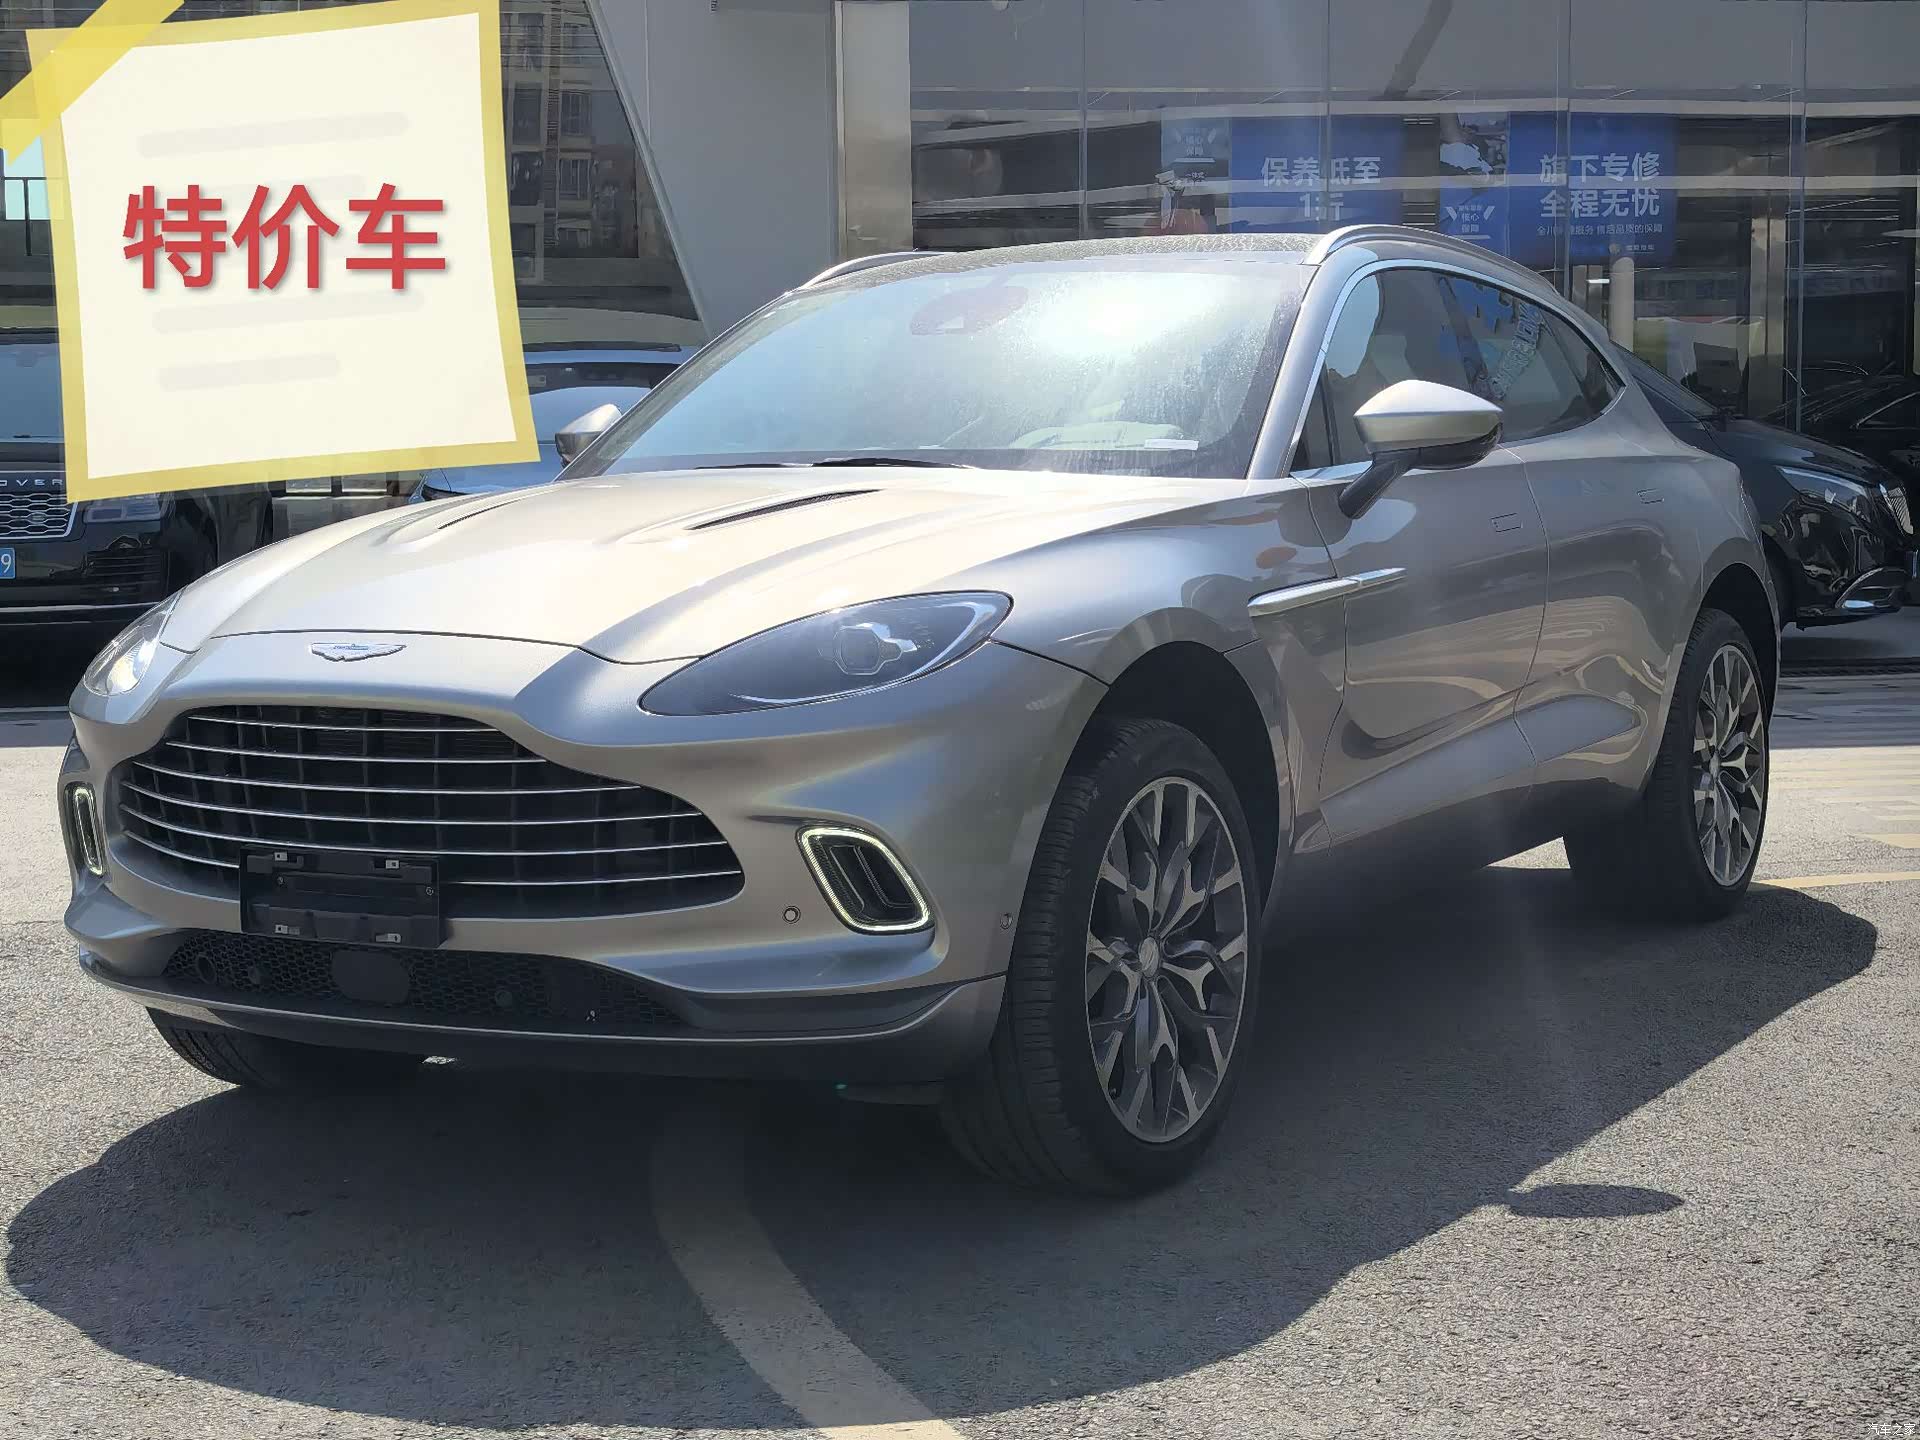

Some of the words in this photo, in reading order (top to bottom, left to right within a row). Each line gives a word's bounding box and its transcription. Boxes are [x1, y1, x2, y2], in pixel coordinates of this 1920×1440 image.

[1261, 156, 1381, 187] 保养低至
[1540, 152, 1660, 183] 旗下专修
[1540, 187, 1660, 218] 全程无忧
